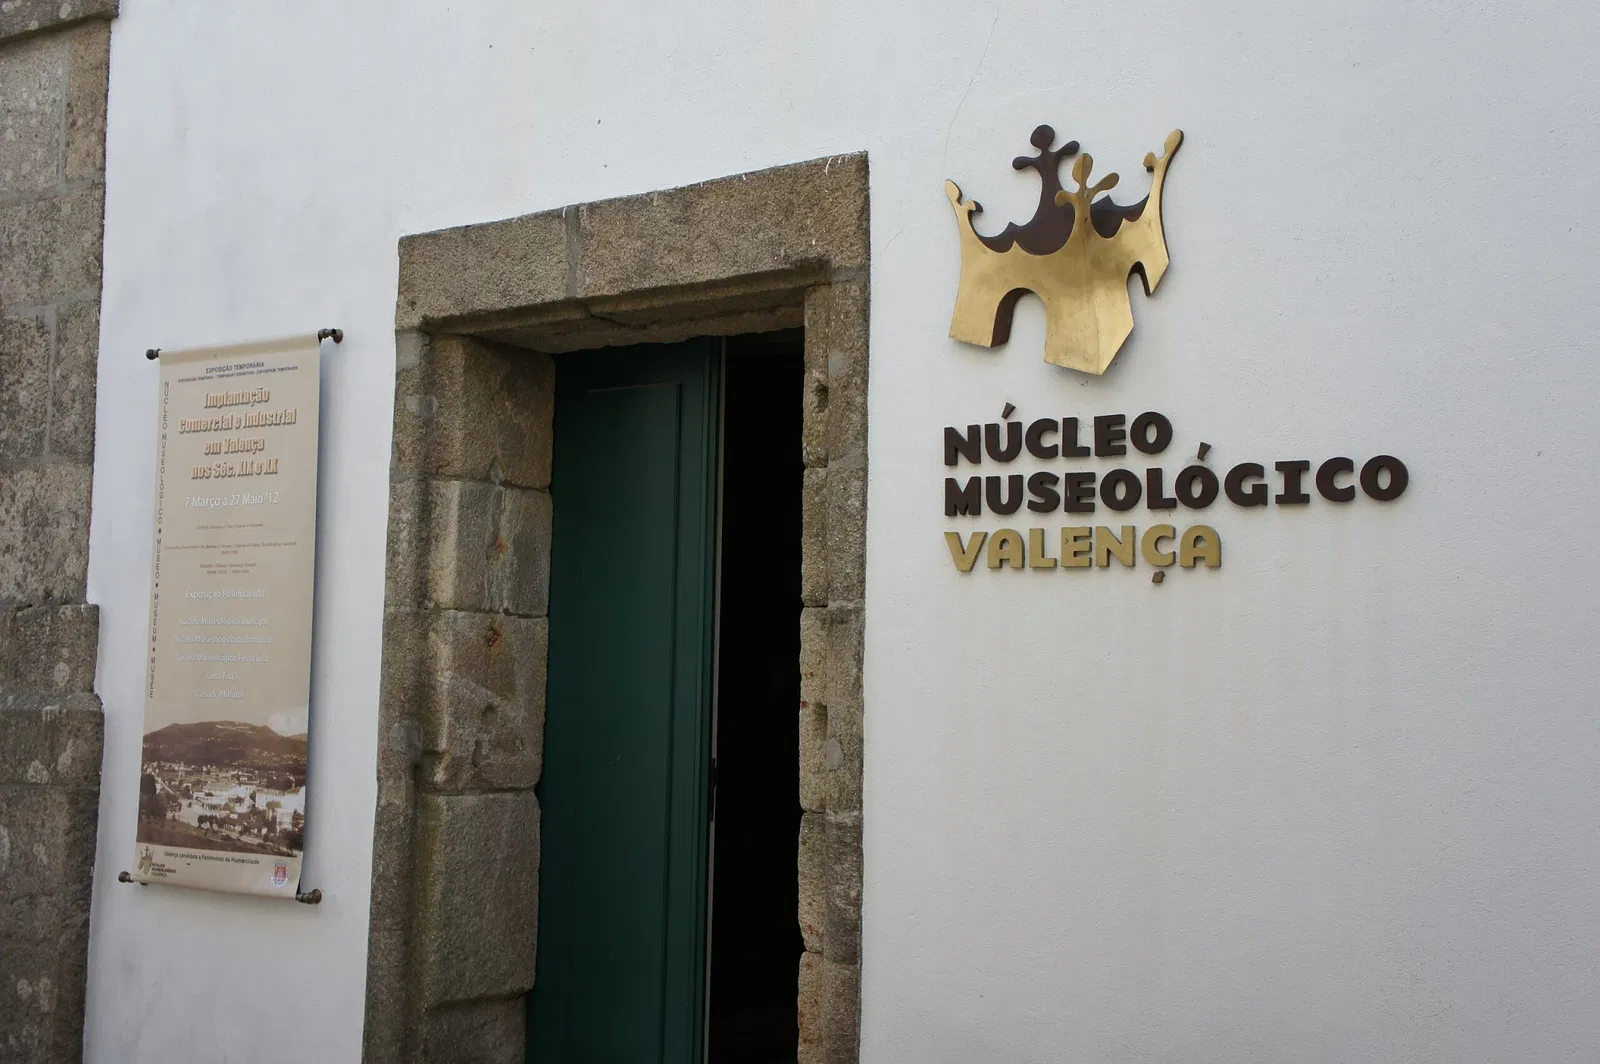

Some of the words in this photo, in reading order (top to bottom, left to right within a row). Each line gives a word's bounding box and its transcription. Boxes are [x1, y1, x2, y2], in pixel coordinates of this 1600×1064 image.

[206, 365, 233, 375] EXPOSIÇÃO
[234, 361, 265, 371] TEMPORÁRIA
[204, 387, 270, 409] Implantação
[179, 414, 234, 434] Comercial
[235, 416, 242, 430] e
[243, 408, 297, 428] Industrial
[944, 402, 1173, 466] NÚCLEO
[204, 440, 221, 455] em
[223, 437, 265, 455] Valença
[191, 465, 211, 479] nos
[213, 462, 236, 477] Séc.
[237, 460, 255, 476] XIX
[255, 462, 262, 475] e
[263, 458, 278, 474] XX
[944, 442, 1409, 517] MUSEOLÓGICO
[184, 496, 190, 507] 7
[192, 496, 221, 508] Março
[223, 497, 228, 506] a
[230, 494, 240, 505] 27
[242, 493, 263, 504] Maio
[944, 525, 1221, 583] VALENÇA
[185, 589, 221, 600] Exposição
[195, 690, 211, 698] Casa
[231, 856, 260, 865] Humanidade
